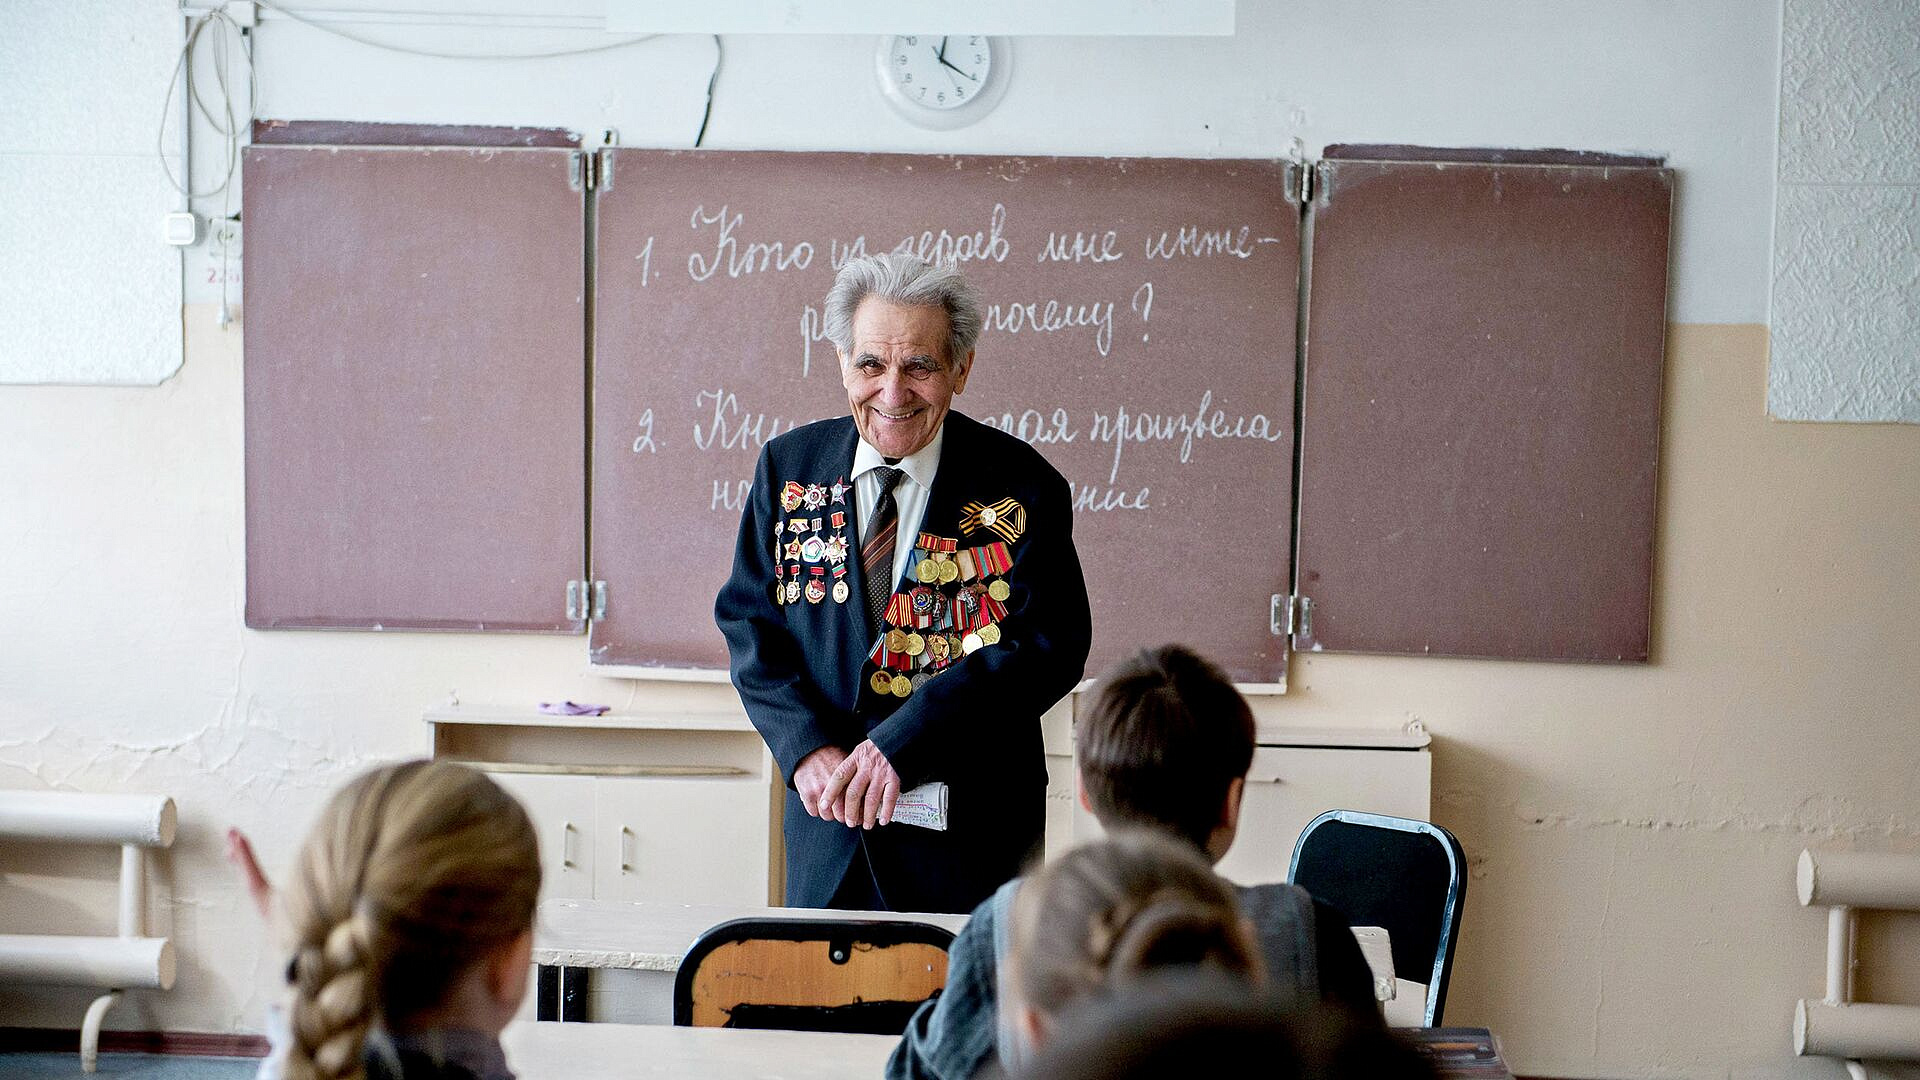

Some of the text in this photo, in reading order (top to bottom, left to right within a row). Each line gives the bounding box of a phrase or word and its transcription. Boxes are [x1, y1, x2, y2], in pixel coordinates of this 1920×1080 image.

[635, 236, 660, 287] 1.
[688, 204, 815, 282] Кто
[1037, 231, 1124, 264] мне
[983, 300, 1114, 356] почему
[632, 408, 666, 454] 2.
[1089, 390, 1282, 484] произвела
